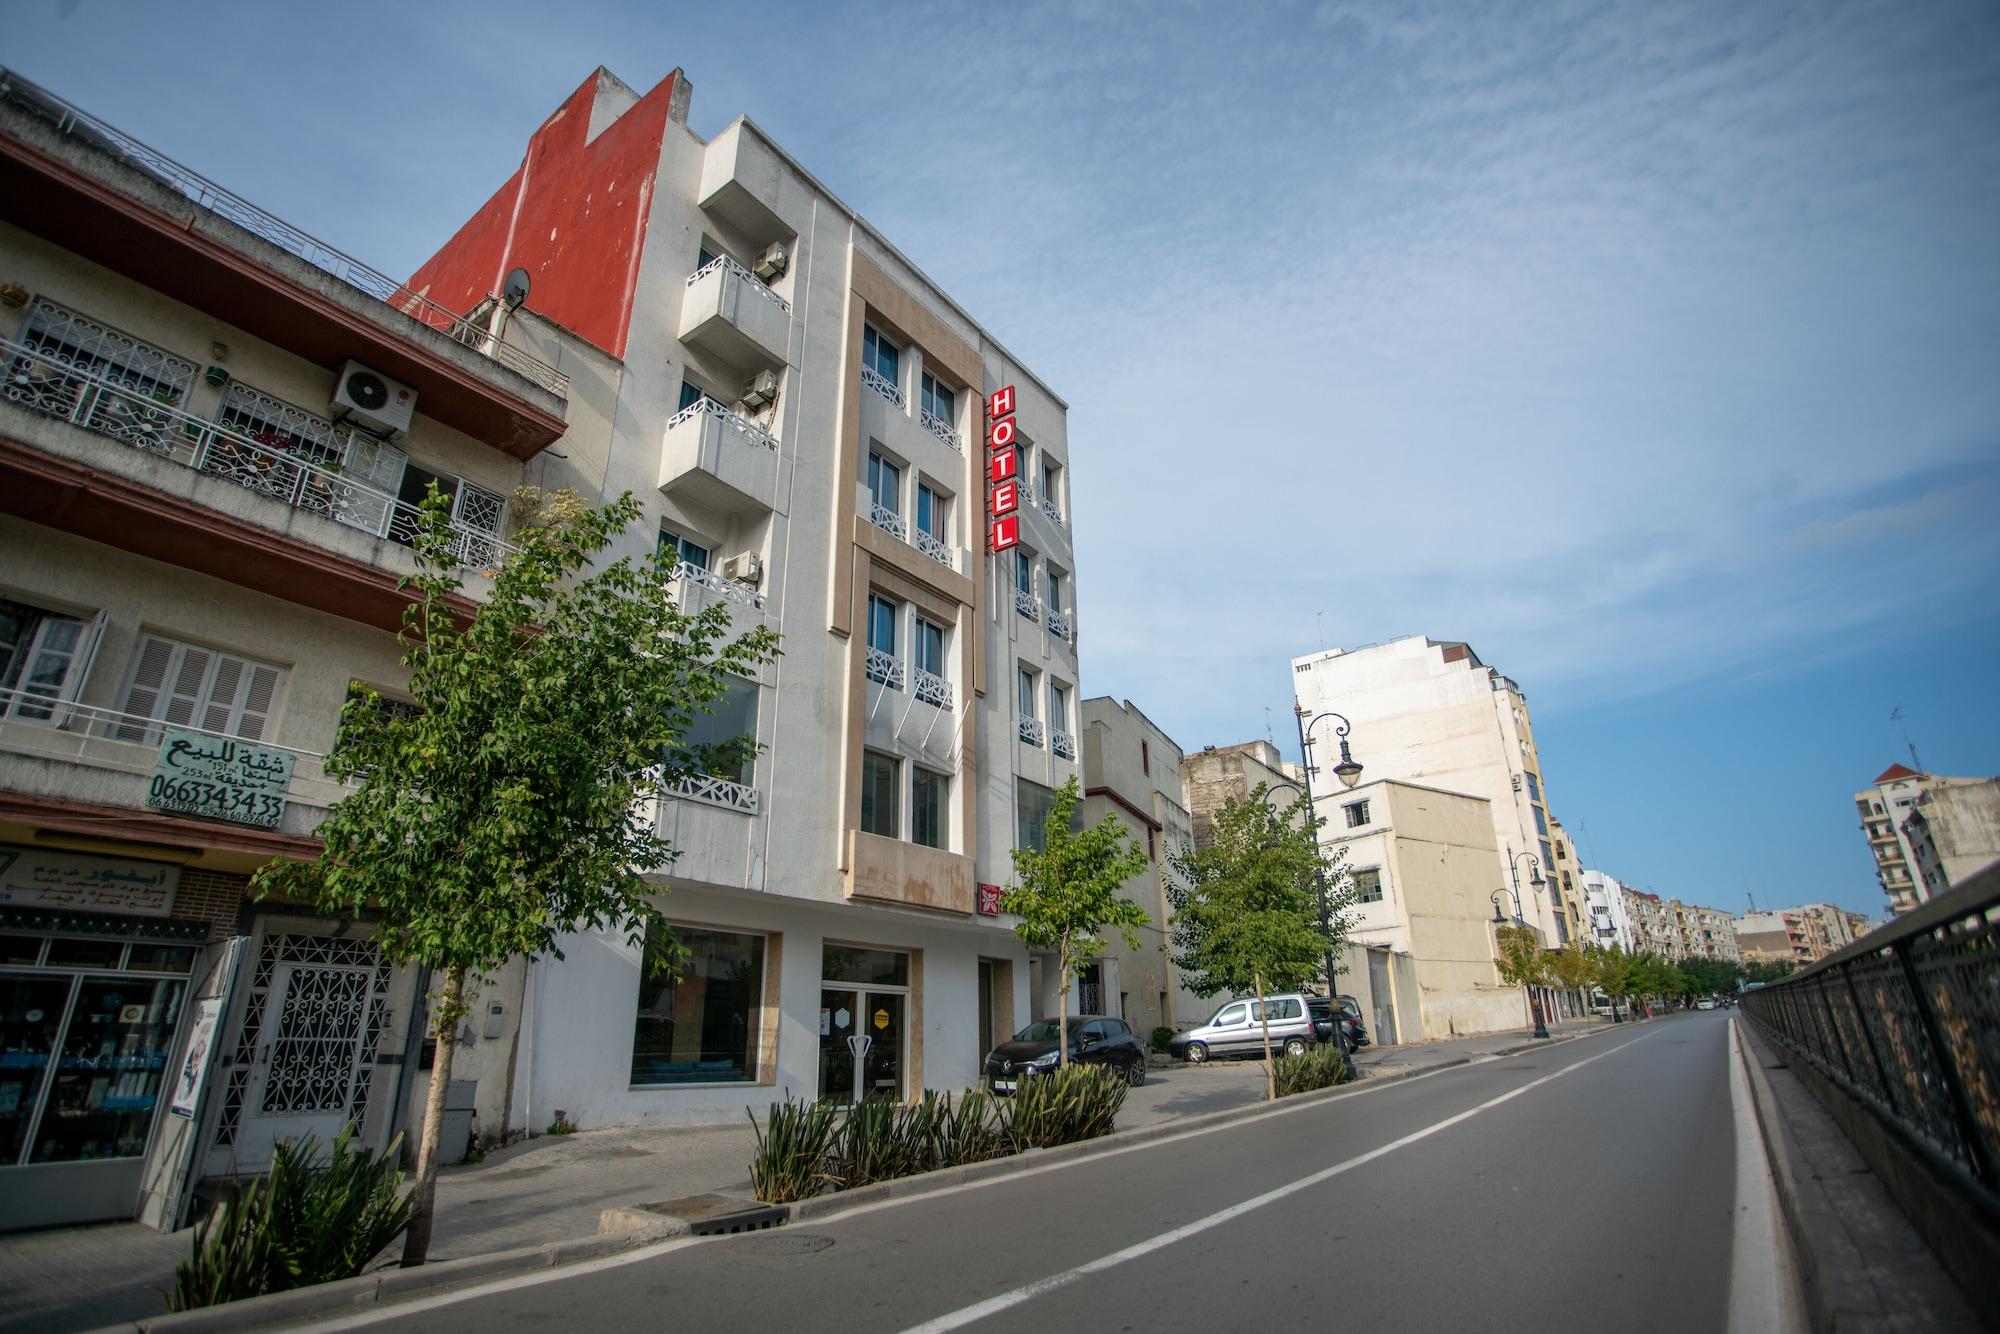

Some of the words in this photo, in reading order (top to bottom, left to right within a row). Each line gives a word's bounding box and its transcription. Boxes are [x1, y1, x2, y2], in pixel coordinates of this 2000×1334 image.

[993, 389, 1013, 547] HOTEL
[166, 740, 235, 768] للبيع
[239, 749, 284, 773] شقة
